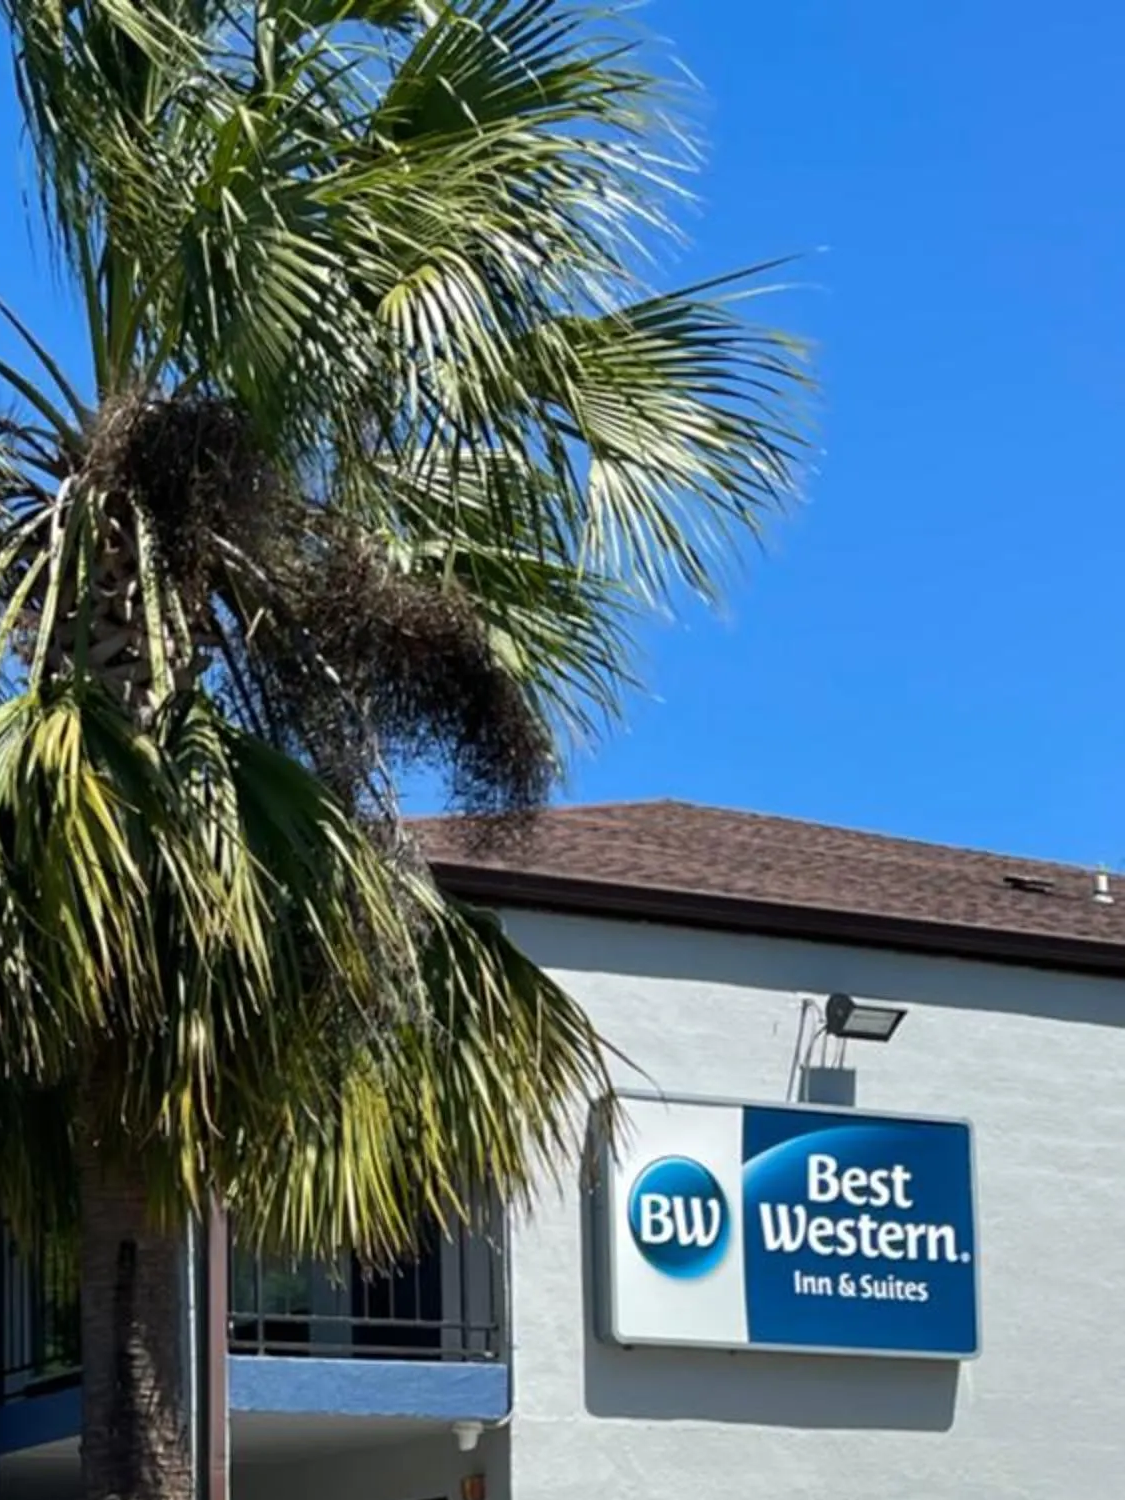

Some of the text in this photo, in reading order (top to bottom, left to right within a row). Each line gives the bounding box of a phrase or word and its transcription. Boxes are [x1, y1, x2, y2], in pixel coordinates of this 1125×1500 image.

[806, 1152, 914, 1210] Best
[639, 1192, 721, 1248] BW
[793, 1269, 930, 1302] Inn & Suites
